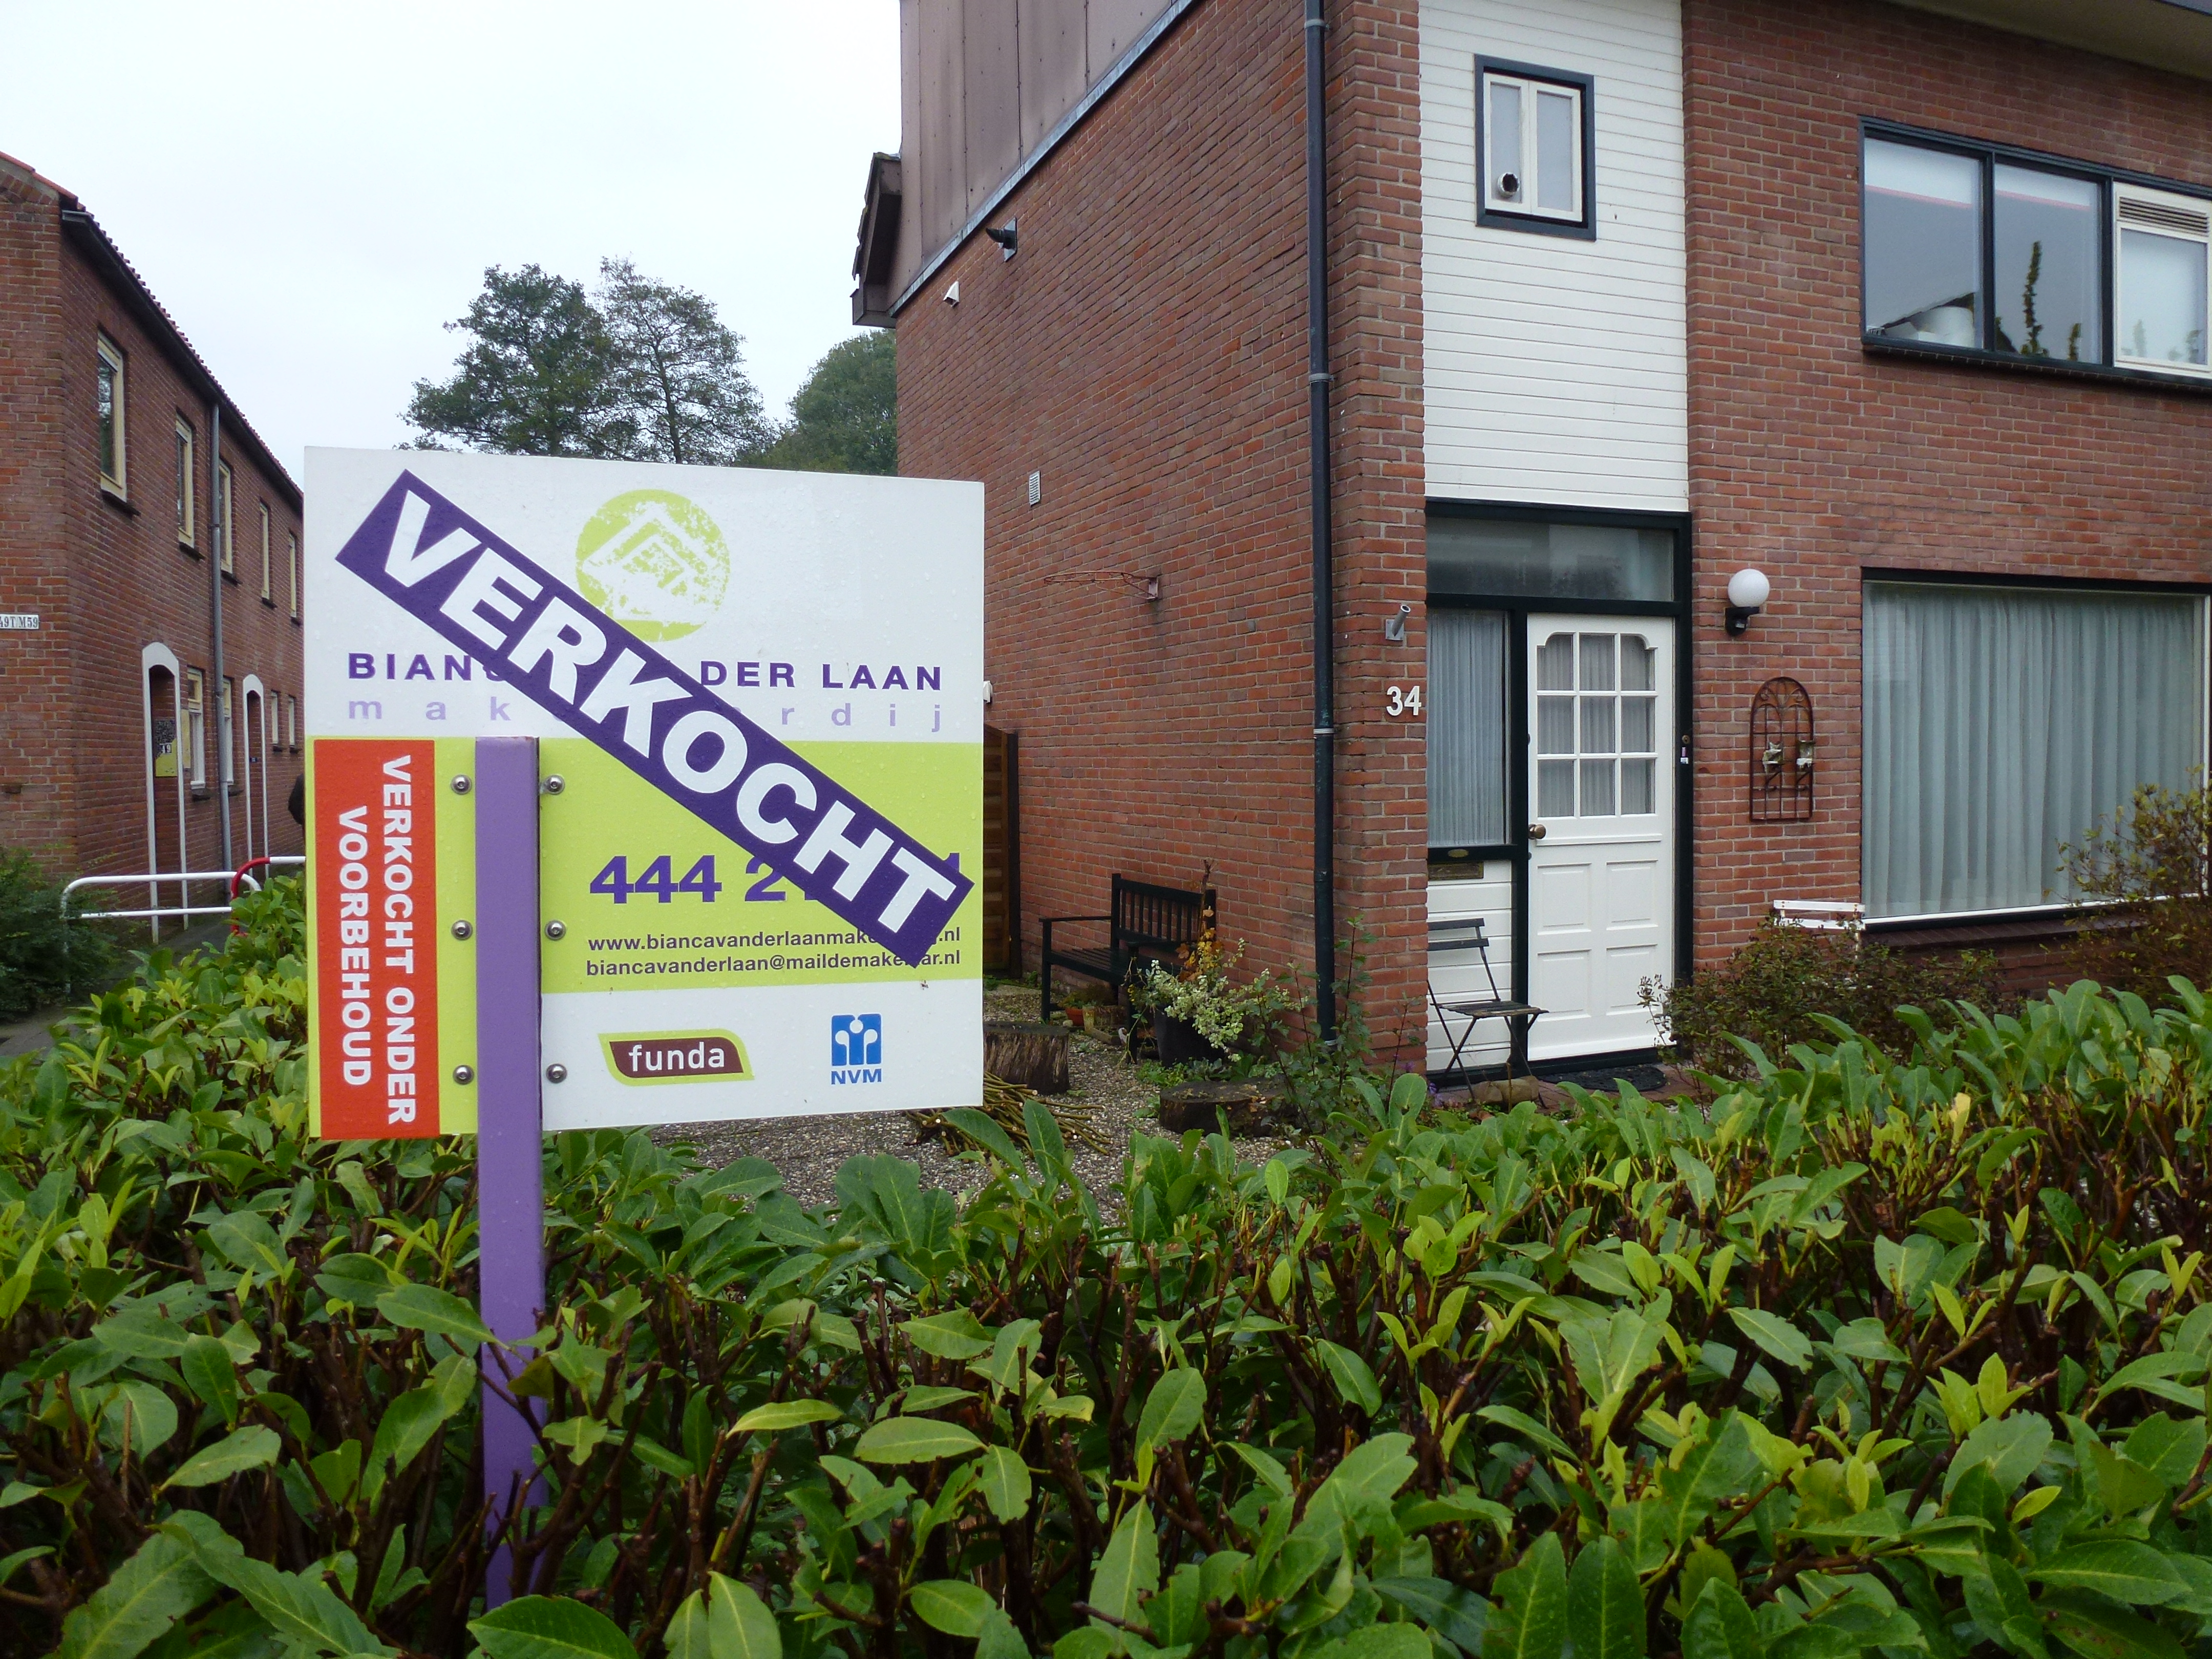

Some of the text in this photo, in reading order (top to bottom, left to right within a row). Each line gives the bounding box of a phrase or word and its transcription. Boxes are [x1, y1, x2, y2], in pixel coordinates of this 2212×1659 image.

[700, 661, 795, 688] DER
[822, 663, 942, 691] LAAN
[385, 488, 956, 933] VERKOCHT
[1386, 685, 1422, 716] 34
[590, 855, 722, 904] 444
[338, 805, 372, 1086] VOORBEHOUD
[382, 754, 417, 1126] VERKOCHT ONDER
[586, 949, 961, 977] biancavanderlaan@maildemakear.nl
[628, 1042, 726, 1072] funda
[831, 1068, 882, 1085] NVM
